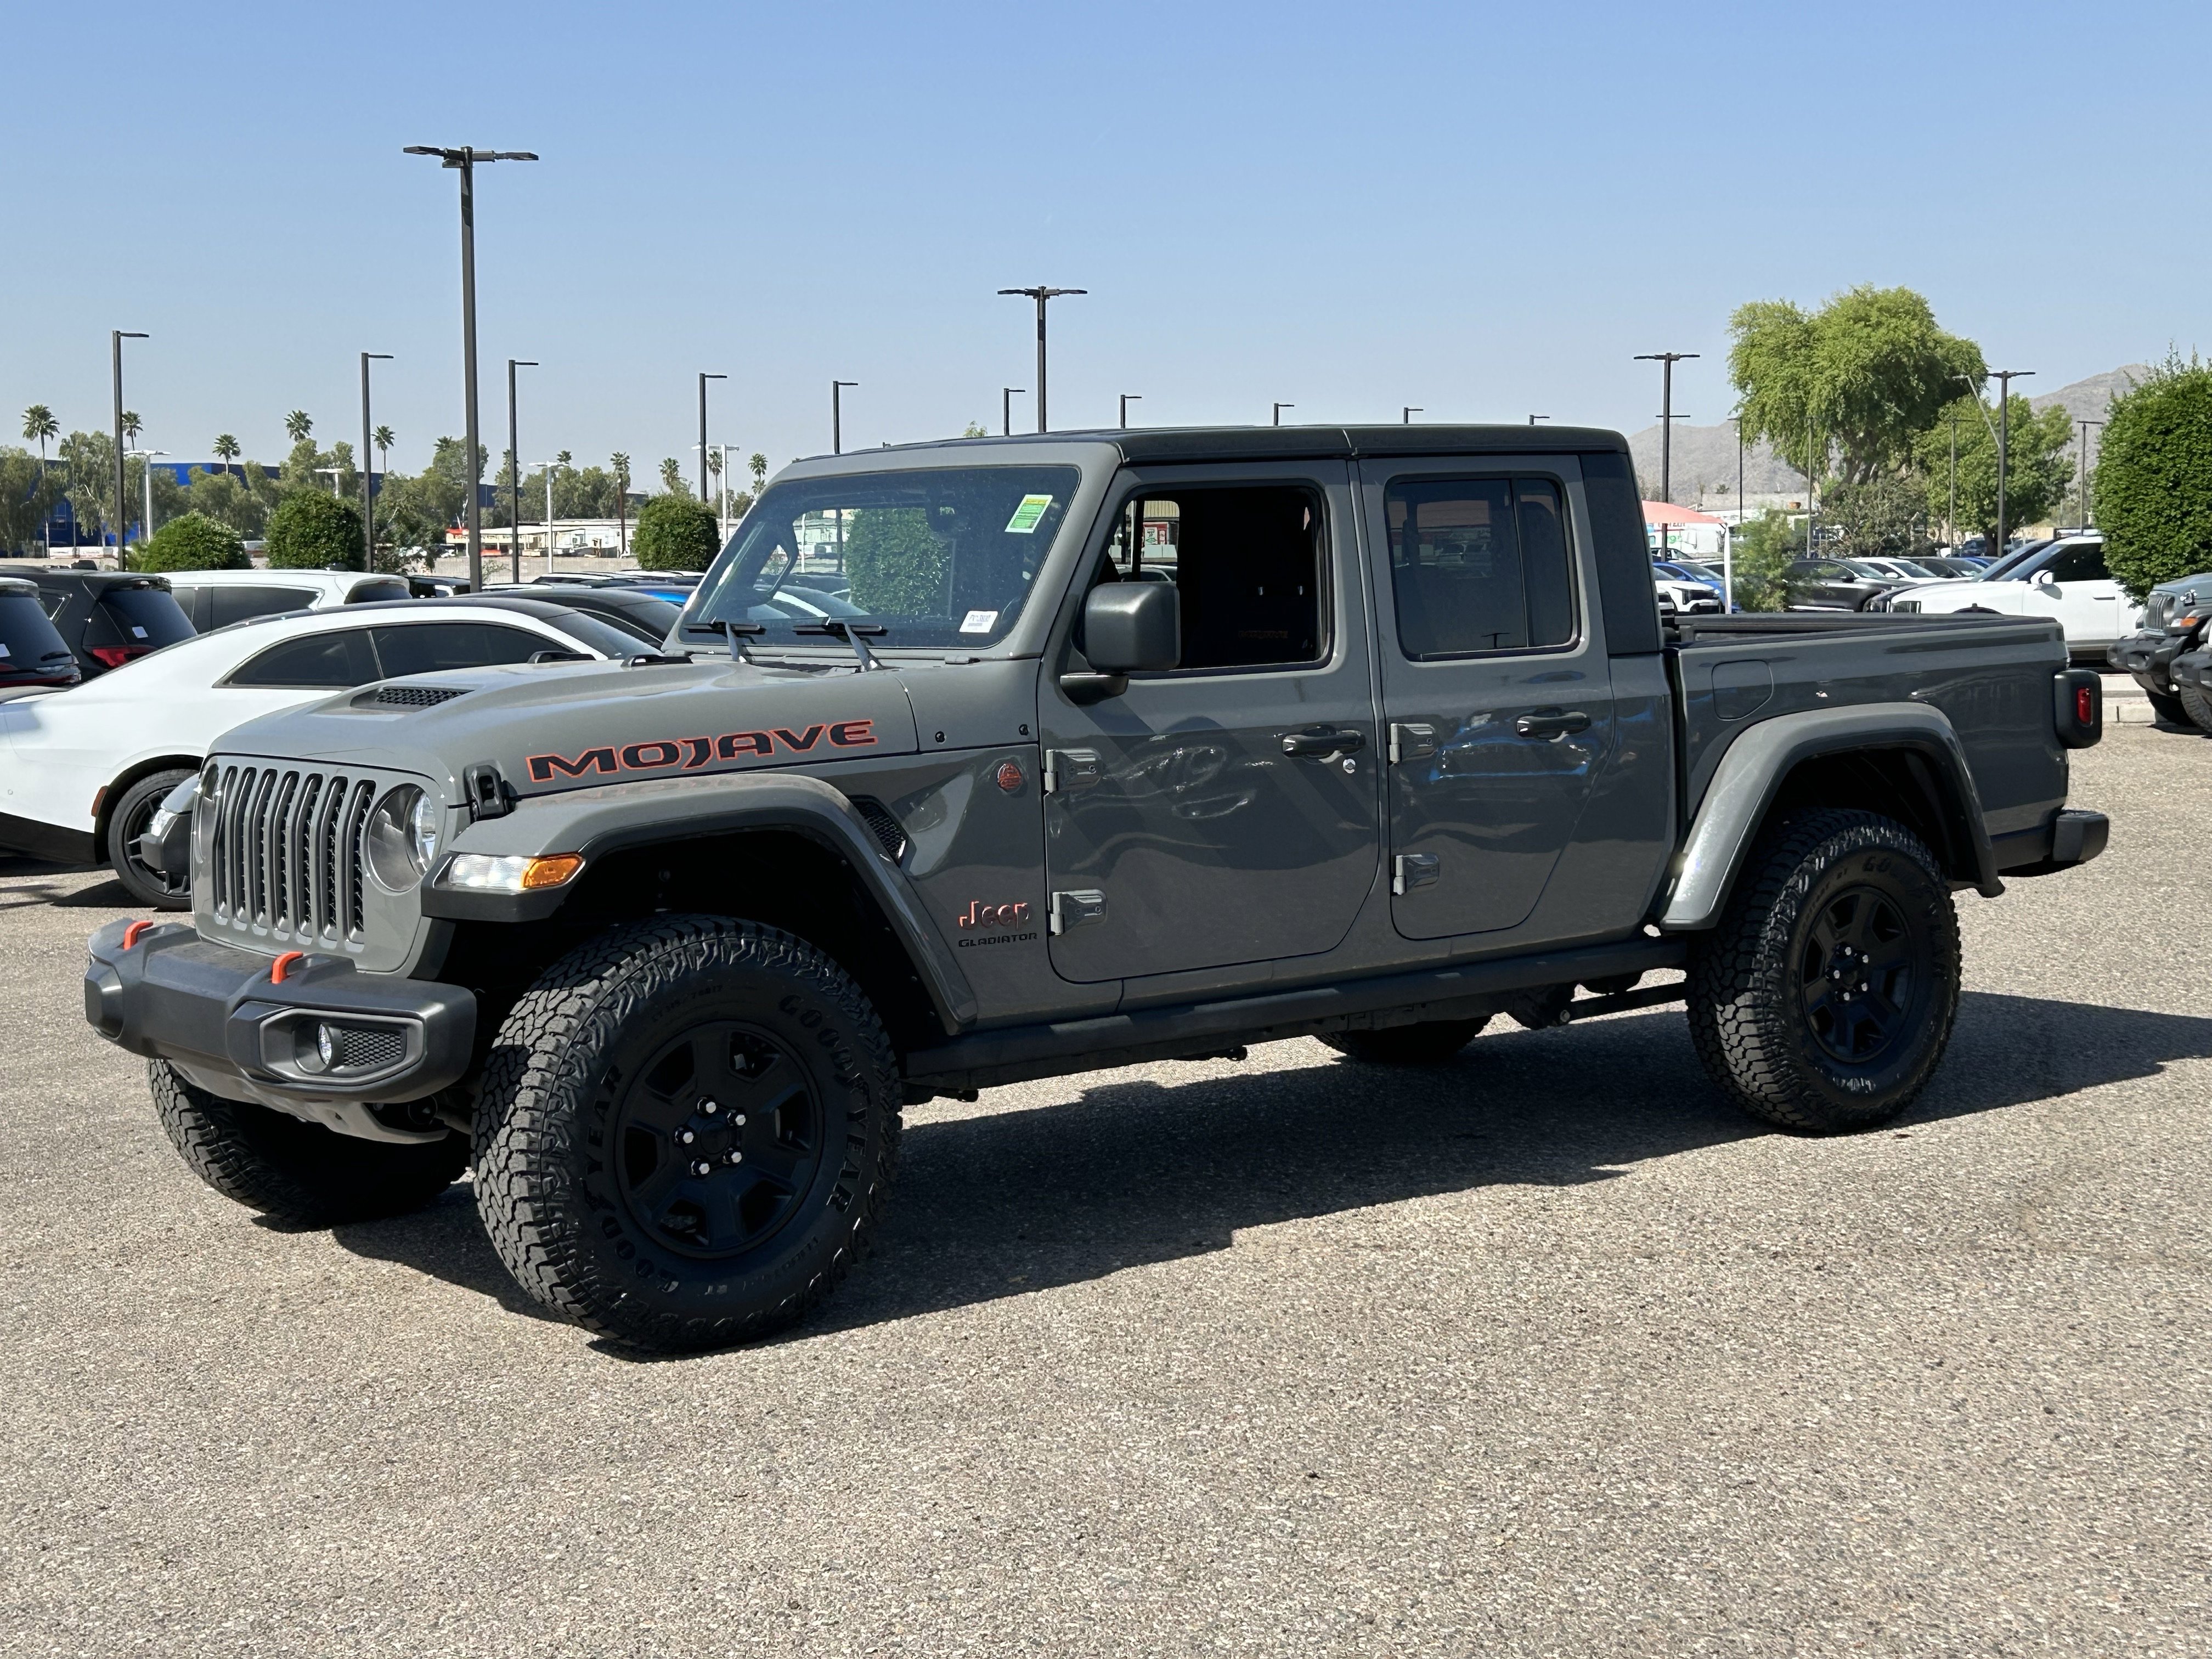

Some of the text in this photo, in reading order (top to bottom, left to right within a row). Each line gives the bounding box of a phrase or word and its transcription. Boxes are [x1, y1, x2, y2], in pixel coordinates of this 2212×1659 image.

[525, 719, 878, 782] MOJAVE
[958, 901, 1029, 930] Jeep
[958, 933, 1037, 947] GLADIATOR
